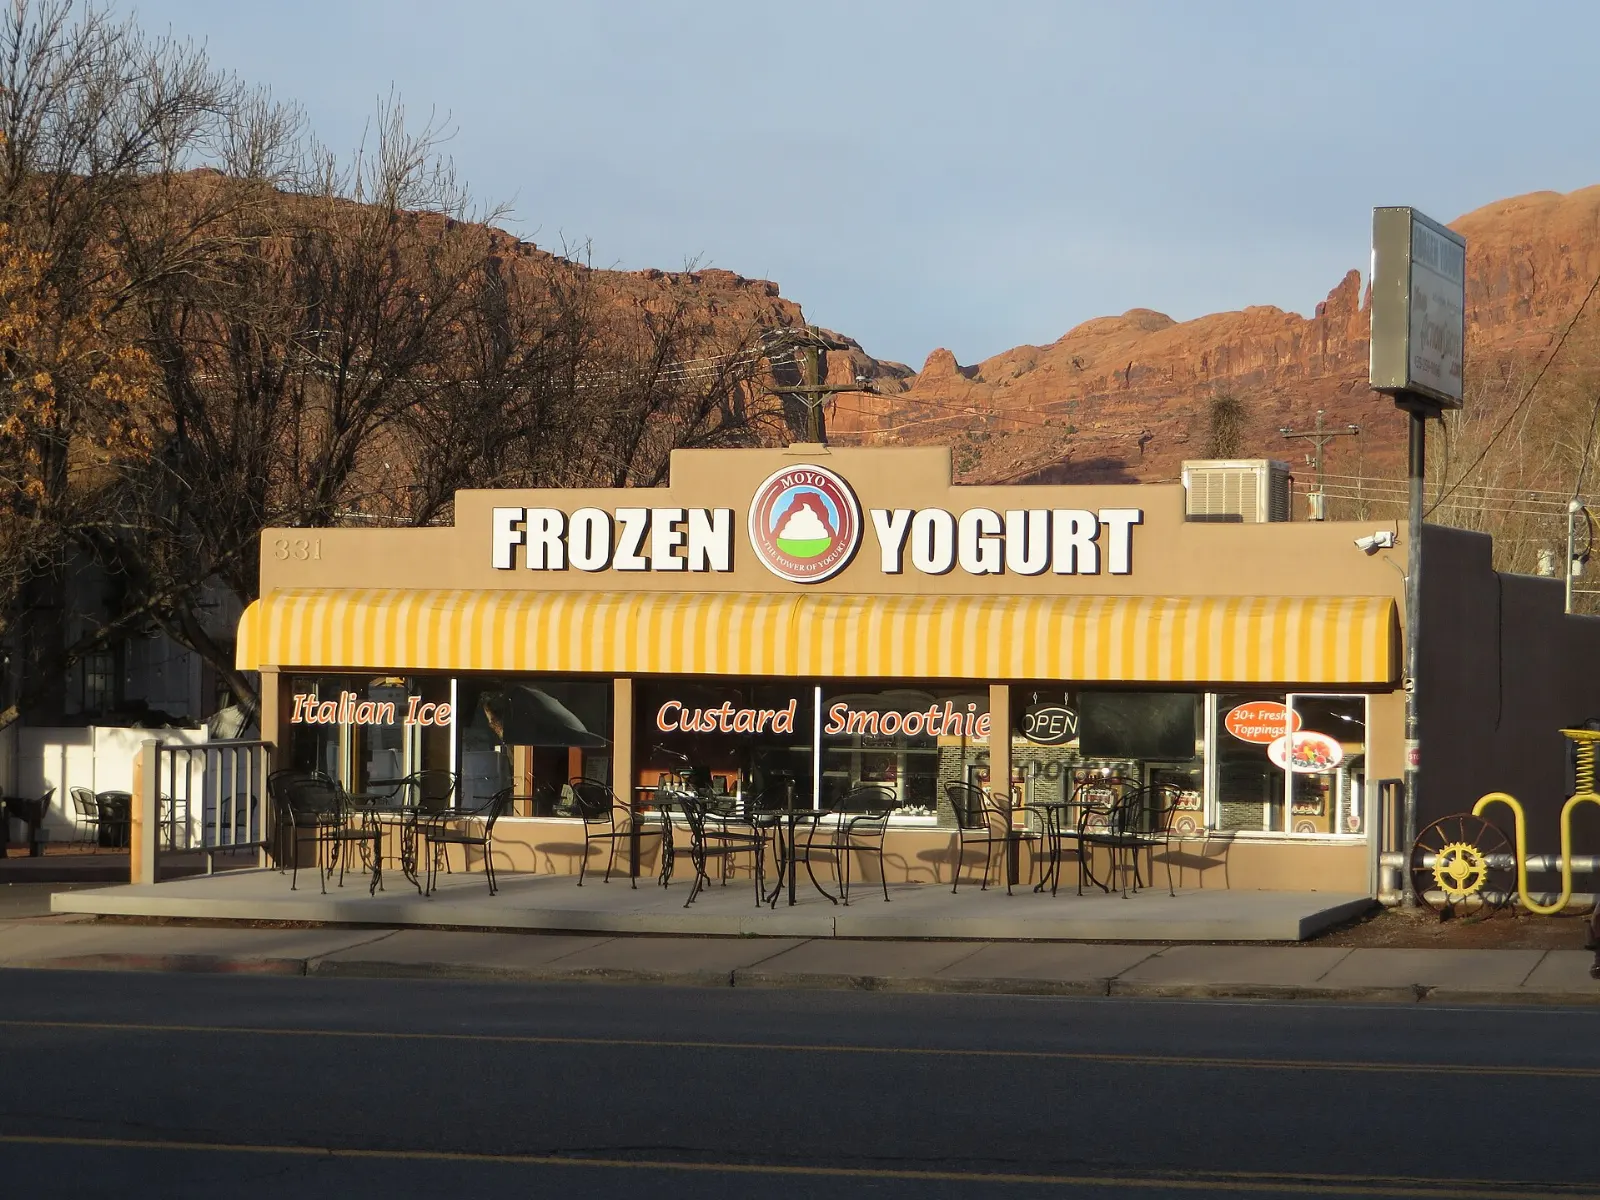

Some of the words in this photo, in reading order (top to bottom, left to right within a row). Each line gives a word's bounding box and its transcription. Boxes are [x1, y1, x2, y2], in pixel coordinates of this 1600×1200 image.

[780, 472, 825, 489] MOYO
[274, 538, 322, 561] 331
[491, 507, 734, 572] FROZEN
[869, 507, 1142, 576] YOGURT
[764, 541, 777, 559] THE
[776, 555, 805, 572] POWER
[806, 563, 818, 572] OF
[818, 541, 846, 568] YOGURT
[291, 690, 396, 725] Italian
[404, 695, 452, 726] Ice
[656, 698, 798, 734] Custard
[1233, 710, 1255, 720] 30+
[1258, 710, 1287, 720] Fresh
[1022, 713, 1078, 734] OPEN
